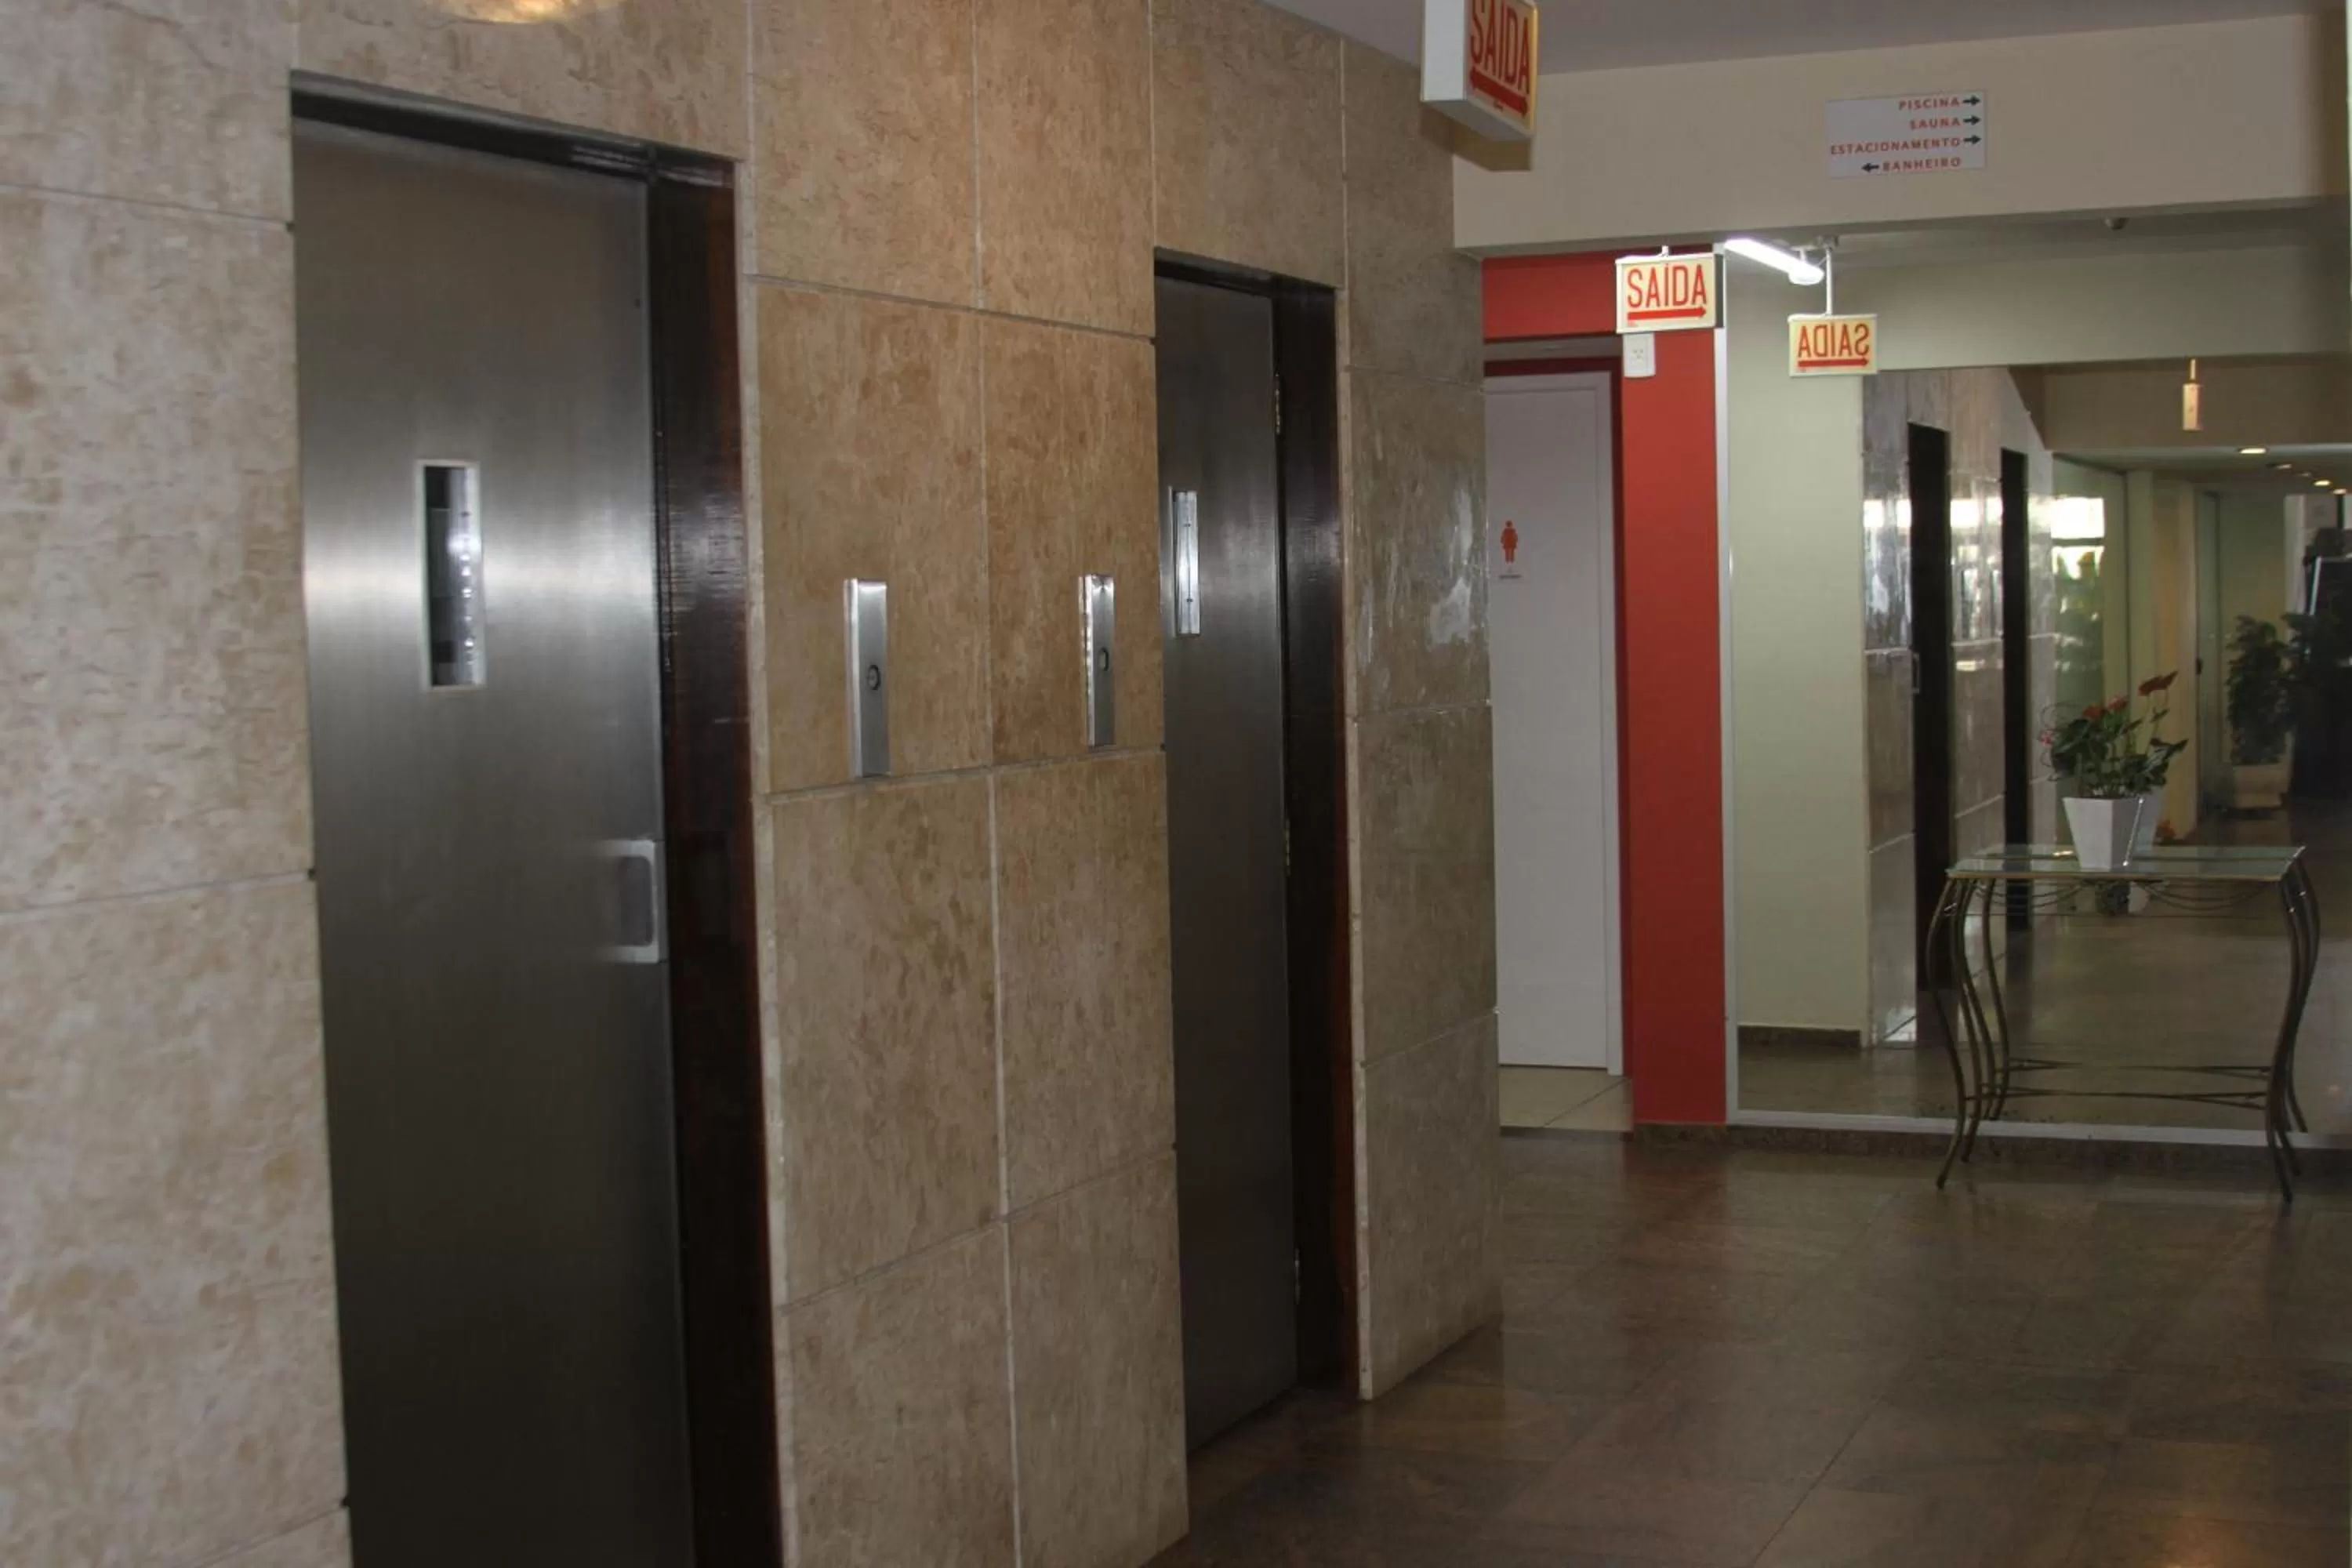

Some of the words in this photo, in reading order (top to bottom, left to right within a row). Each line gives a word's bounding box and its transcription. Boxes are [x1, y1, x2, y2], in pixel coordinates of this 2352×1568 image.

[1898, 97, 1960, 111] PISCINA
[1910, 117, 1961, 131] SAUNA
[1830, 137, 1961, 155] ESTACIONAMENTO
[1882, 157, 1962, 172] BANHEIRO
